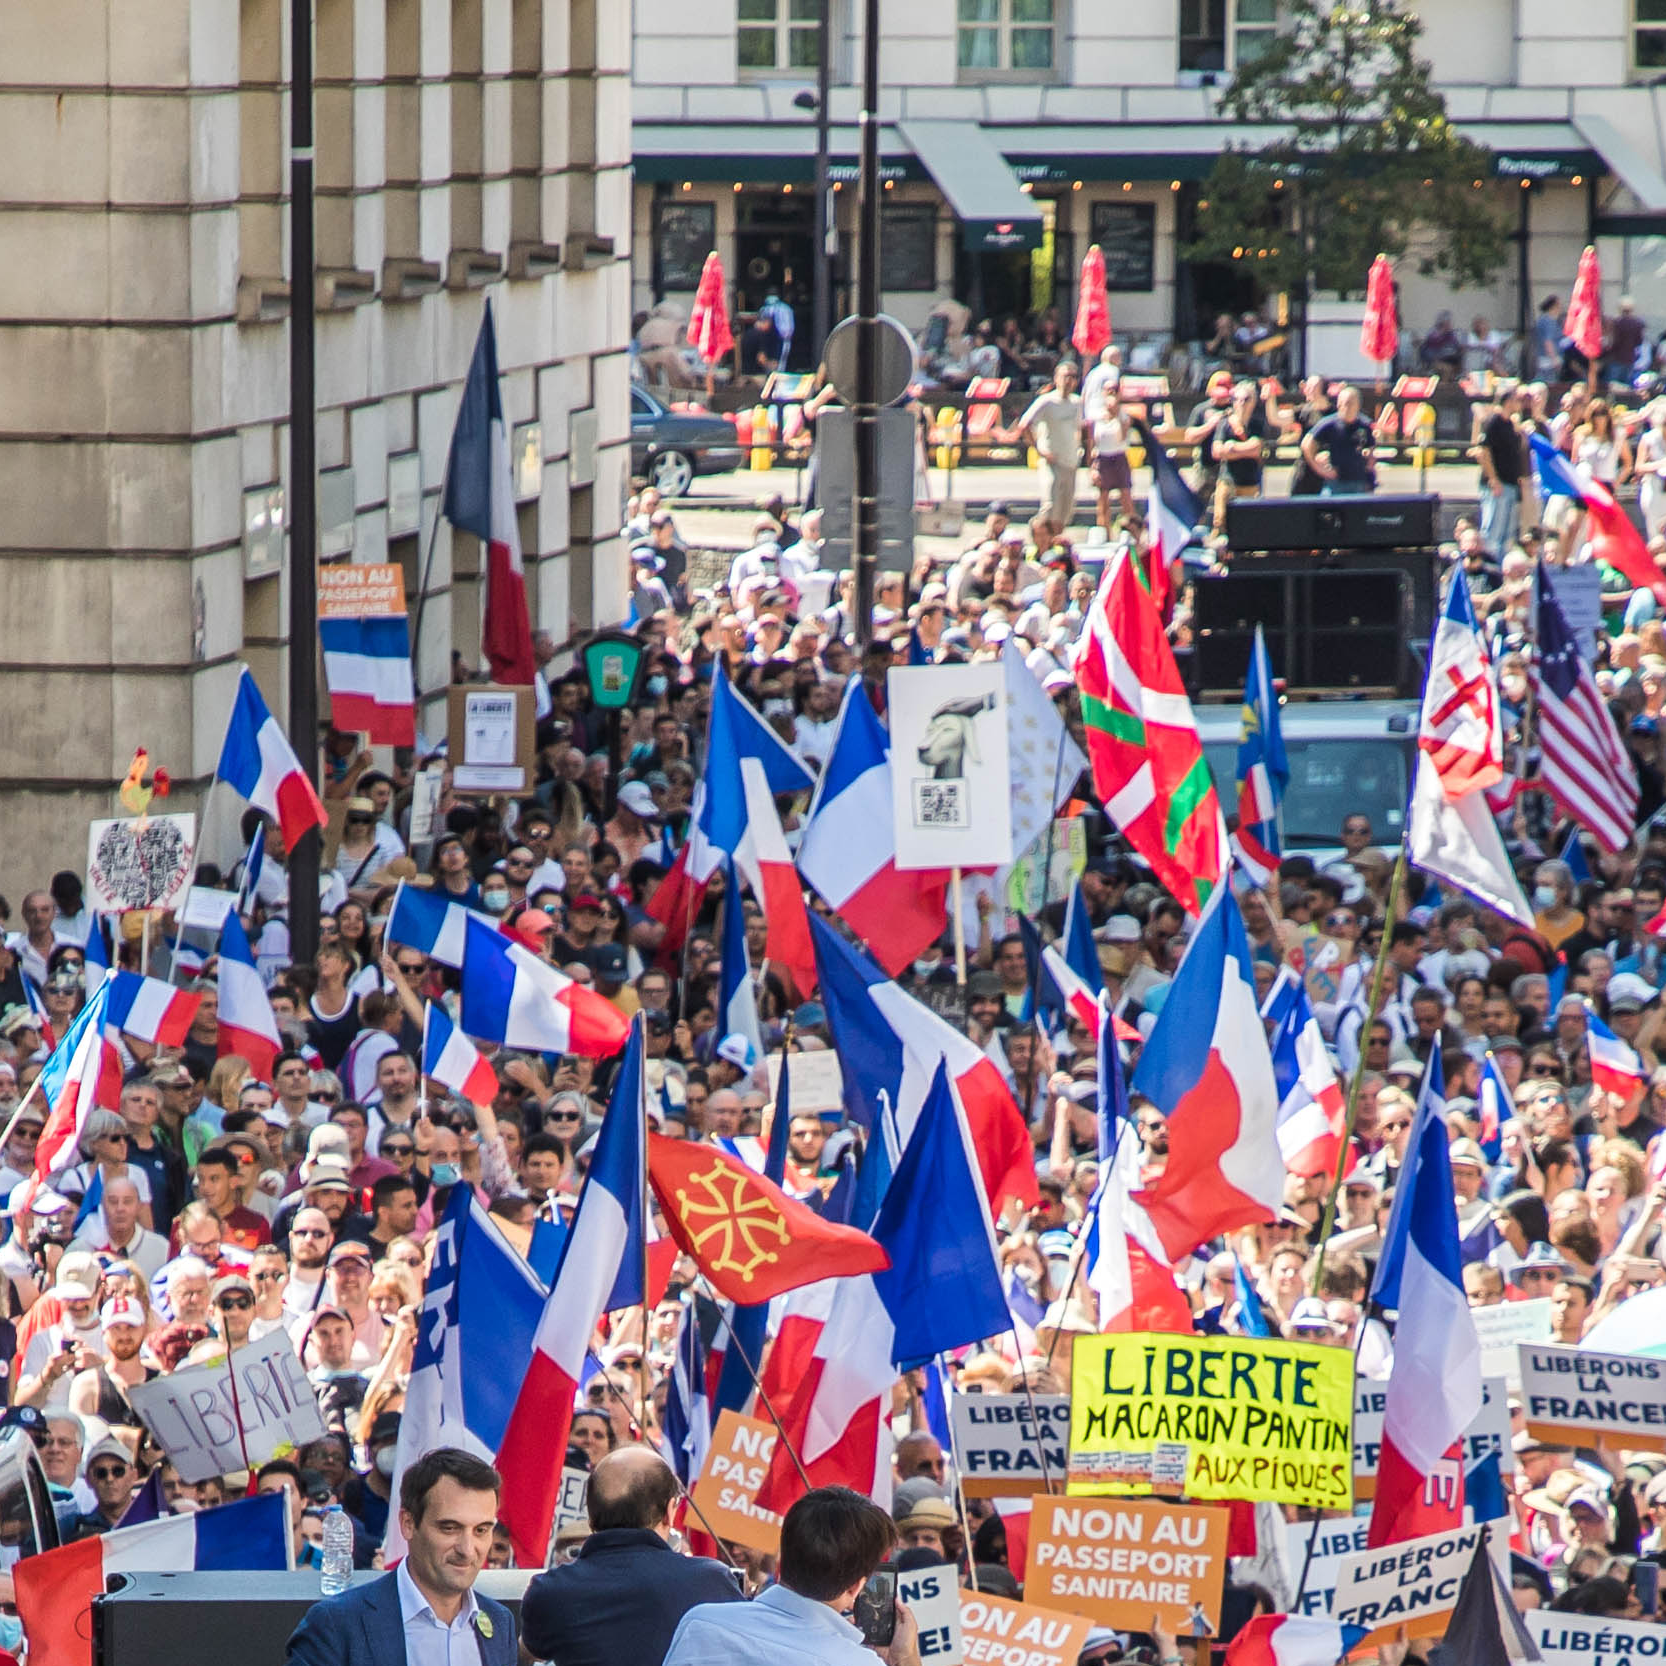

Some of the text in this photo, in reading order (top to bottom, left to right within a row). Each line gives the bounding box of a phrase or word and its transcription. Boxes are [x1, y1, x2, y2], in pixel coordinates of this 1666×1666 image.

[321, 568, 395, 585] NON AU
[317, 587, 398, 600] PASSEPORT
[1532, 1352, 1661, 1380] LIBÉRONS
[1578, 1375, 1612, 1394] LA
[1021, 1424, 1059, 1442] LA
[1084, 1401, 1237, 1444] MACARON
[1194, 1454, 1247, 1487] AUX
[1051, 1507, 1209, 1548] NON AU
[1036, 1543, 1212, 1579] PASSEPORT
[900, 1577, 941, 1603] NS
[1050, 1573, 1191, 1605] SANITAIRE
[1397, 1565, 1434, 1588] LA
[1016, 1615, 1073, 1650] AU
